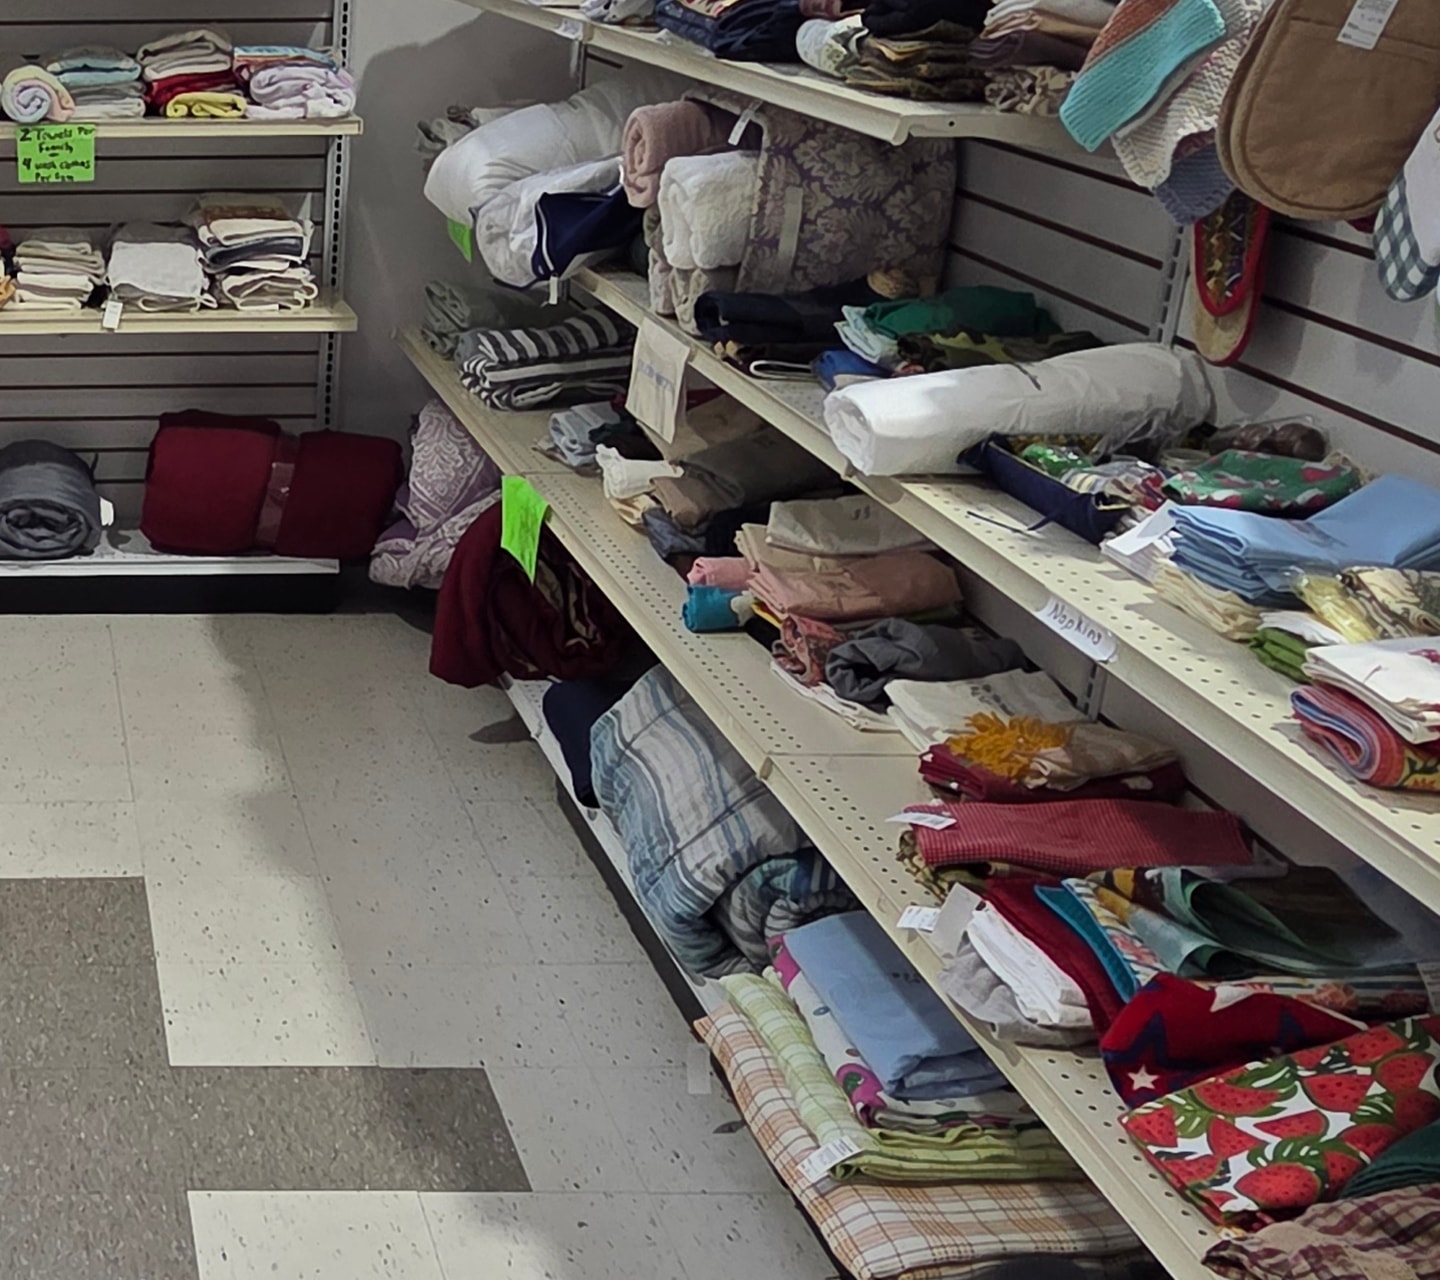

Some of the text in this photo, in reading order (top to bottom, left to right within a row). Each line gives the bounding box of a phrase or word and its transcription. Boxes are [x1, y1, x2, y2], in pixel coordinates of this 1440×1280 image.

[20, 128, 32, 142] 2
[22, 157, 32, 171] 4
[1047, 602, 1102, 646] Napkins
